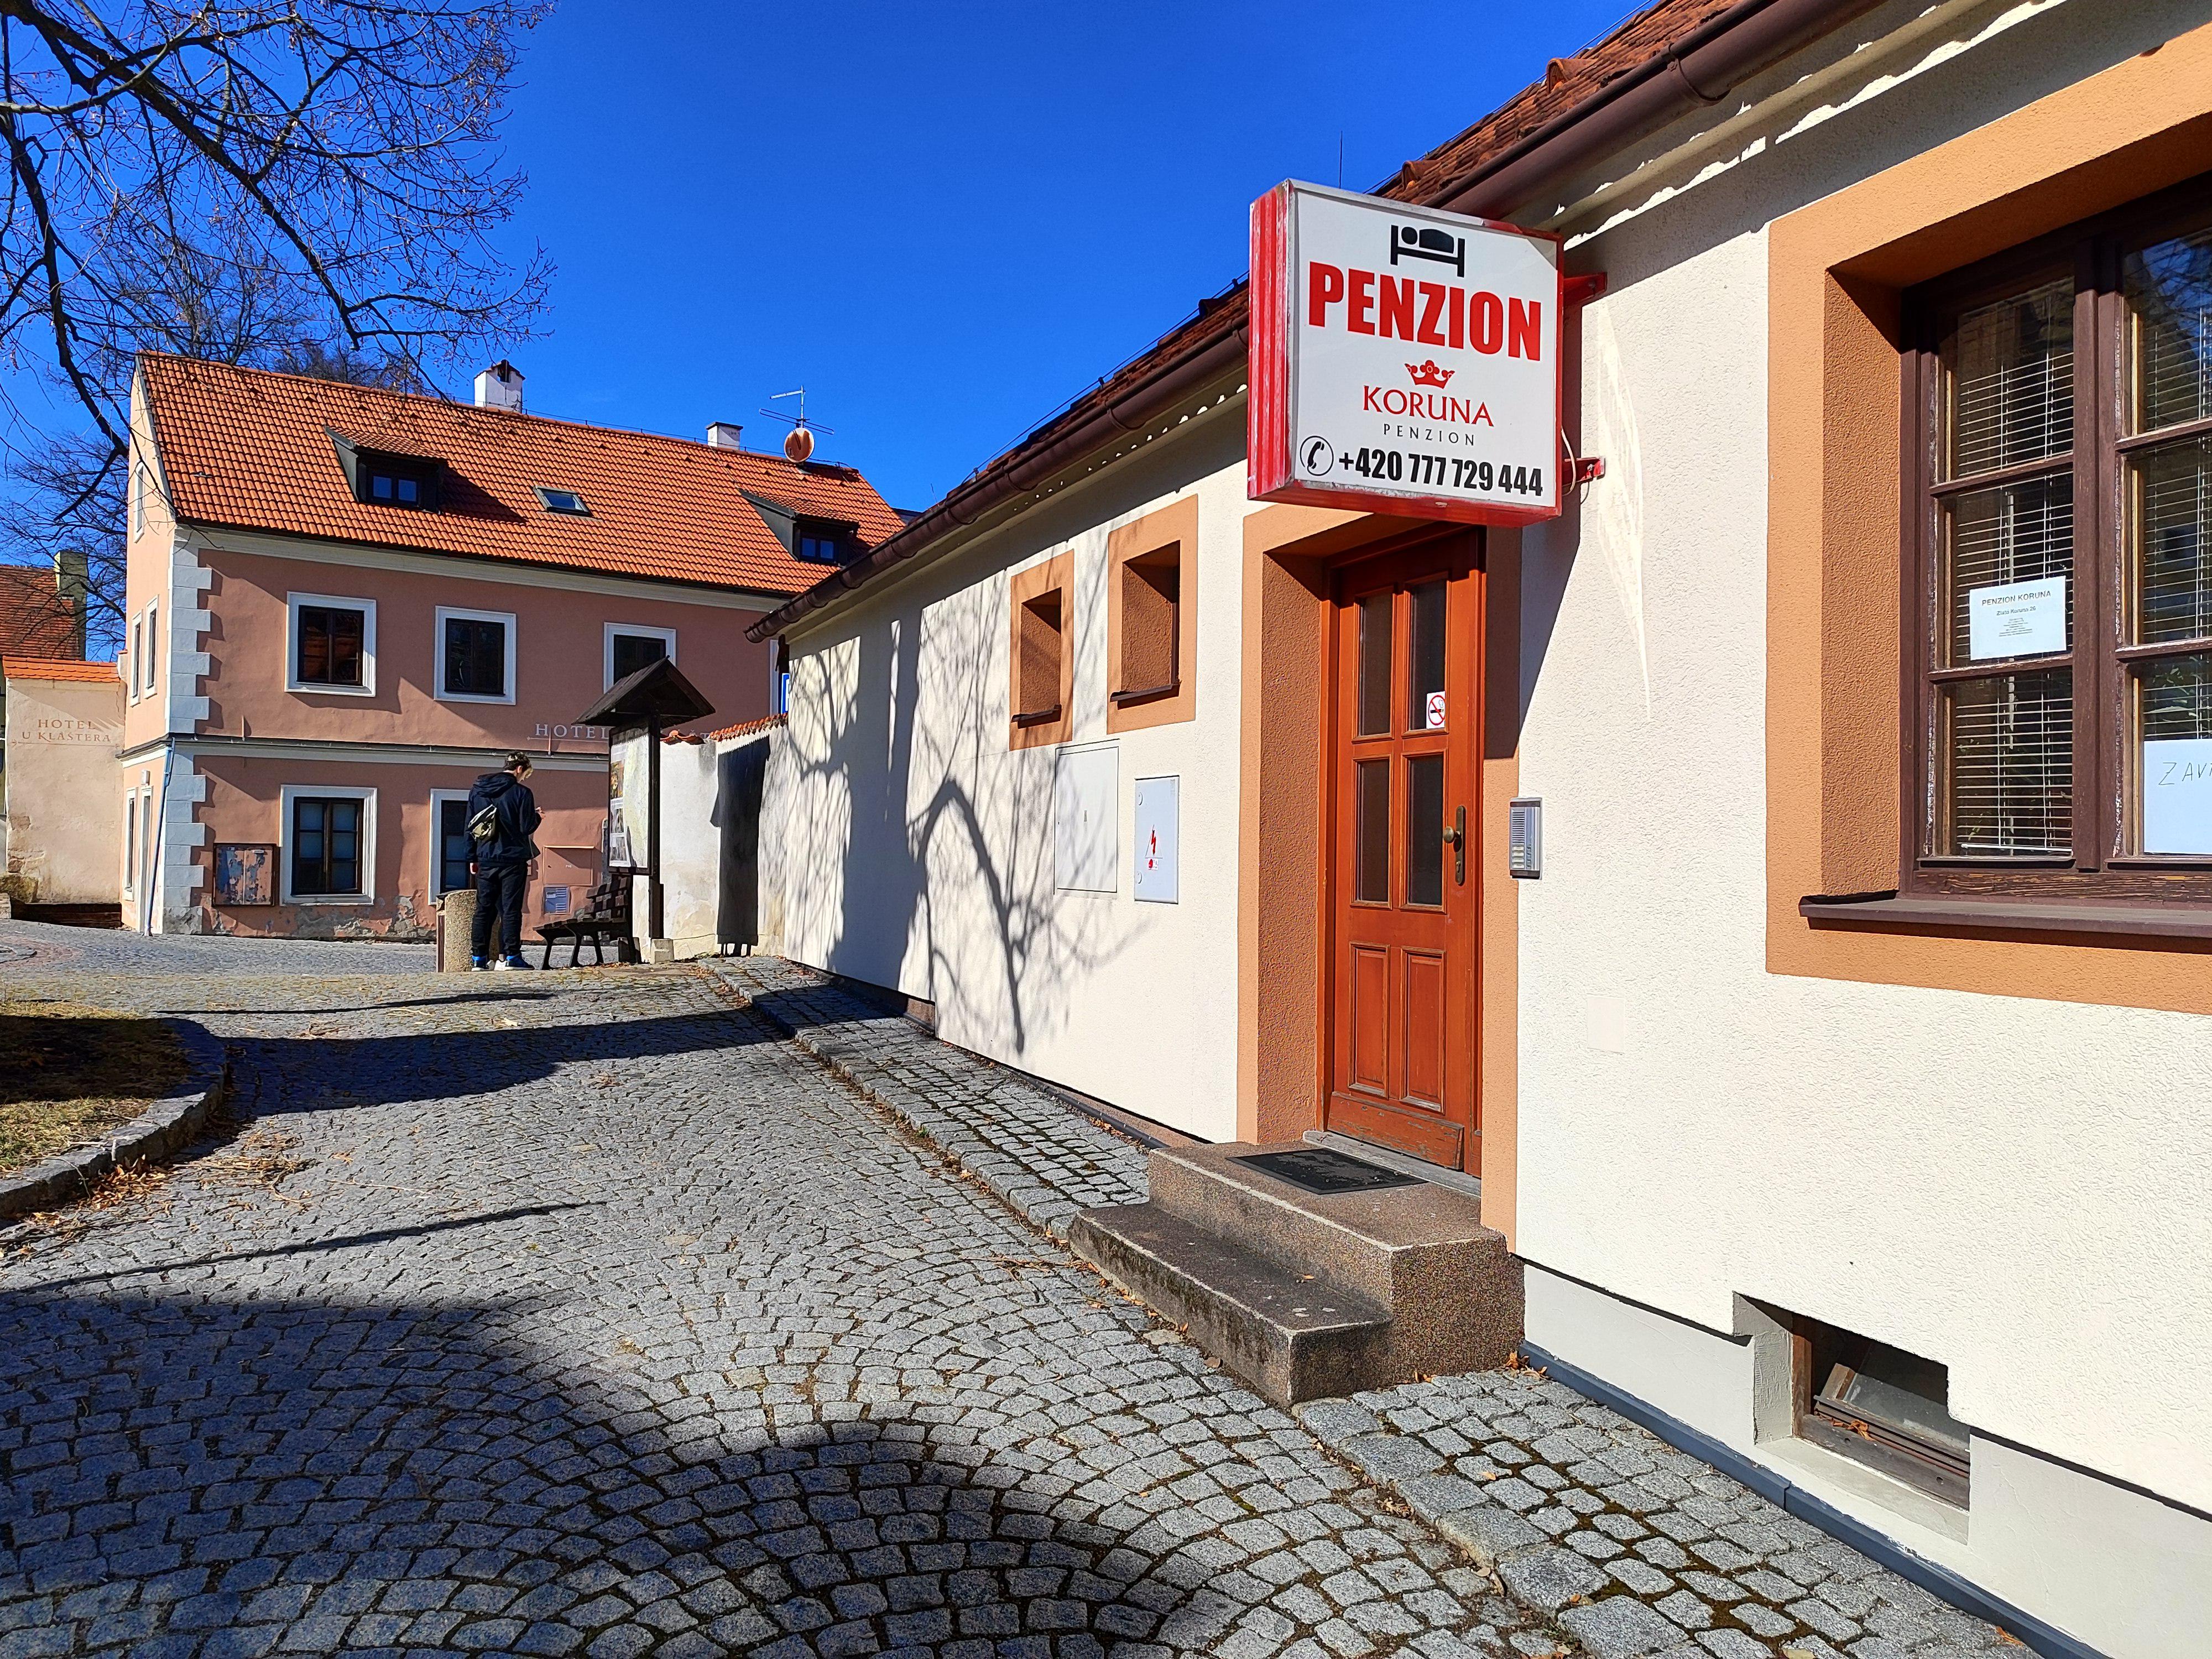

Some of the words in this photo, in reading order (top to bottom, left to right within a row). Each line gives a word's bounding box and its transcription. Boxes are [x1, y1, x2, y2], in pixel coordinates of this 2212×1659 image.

[1308, 261, 1542, 362] PENZION
[1363, 384, 1494, 427] KORUNA
[1384, 423, 1474, 446] PENZION
[1339, 447, 1402, 481] +420
[1408, 452, 1447, 486] 777
[1451, 458, 1493, 491] 729
[1498, 465, 1543, 497] 444
[1982, 595, 2016, 606] PENZION
[2018, 590, 2051, 601] KORUNA
[22, 731, 31, 740] U
[38, 719, 96, 730] HOTEL
[535, 723, 609, 739] HOTEL
[2158, 762, 2212, 786] ZAV
